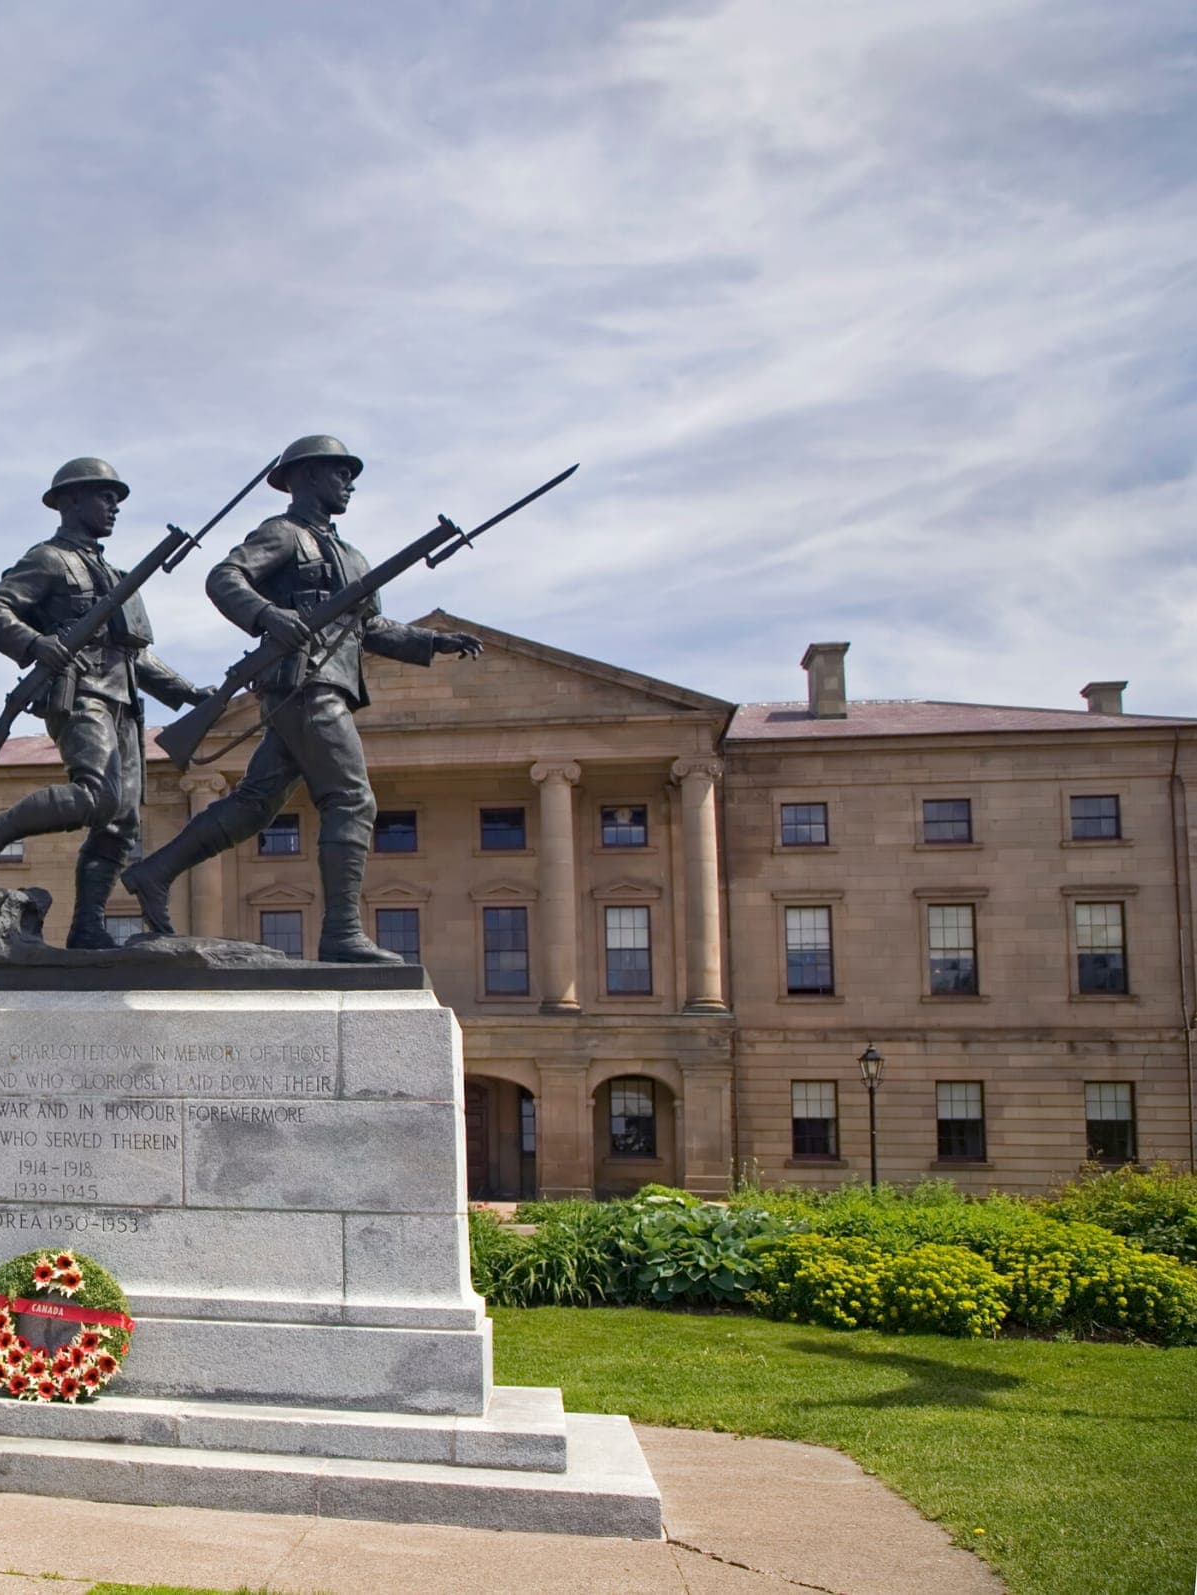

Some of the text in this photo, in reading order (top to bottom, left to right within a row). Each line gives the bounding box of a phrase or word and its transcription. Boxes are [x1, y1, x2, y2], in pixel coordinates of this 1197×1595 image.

[9, 1043, 142, 1061] CHARLOTTETOWN
[151, 1045, 166, 1061] IN
[175, 1045, 242, 1062] MEMORY
[249, 1045, 272, 1062] OF
[278, 1045, 332, 1063] THOSE
[26, 1072, 64, 1089] WHO
[71, 1073, 168, 1091] GLORIOUSLY
[176, 1074, 212, 1091] LAID
[220, 1074, 273, 1092] DOWN
[283, 1075, 332, 1093] THEIR
[36, 1102, 69, 1119] AND
[79, 1104, 94, 1120] IN
[105, 1104, 176, 1122] HONOUR
[188, 1105, 306, 1124] FOREVERMORE
[0, 1130, 38, 1147] WHO
[44, 1131, 102, 1149] SERVED
[111, 1132, 178, 1150] THEREIN
[31, 1303, 65, 1316] CANADA
